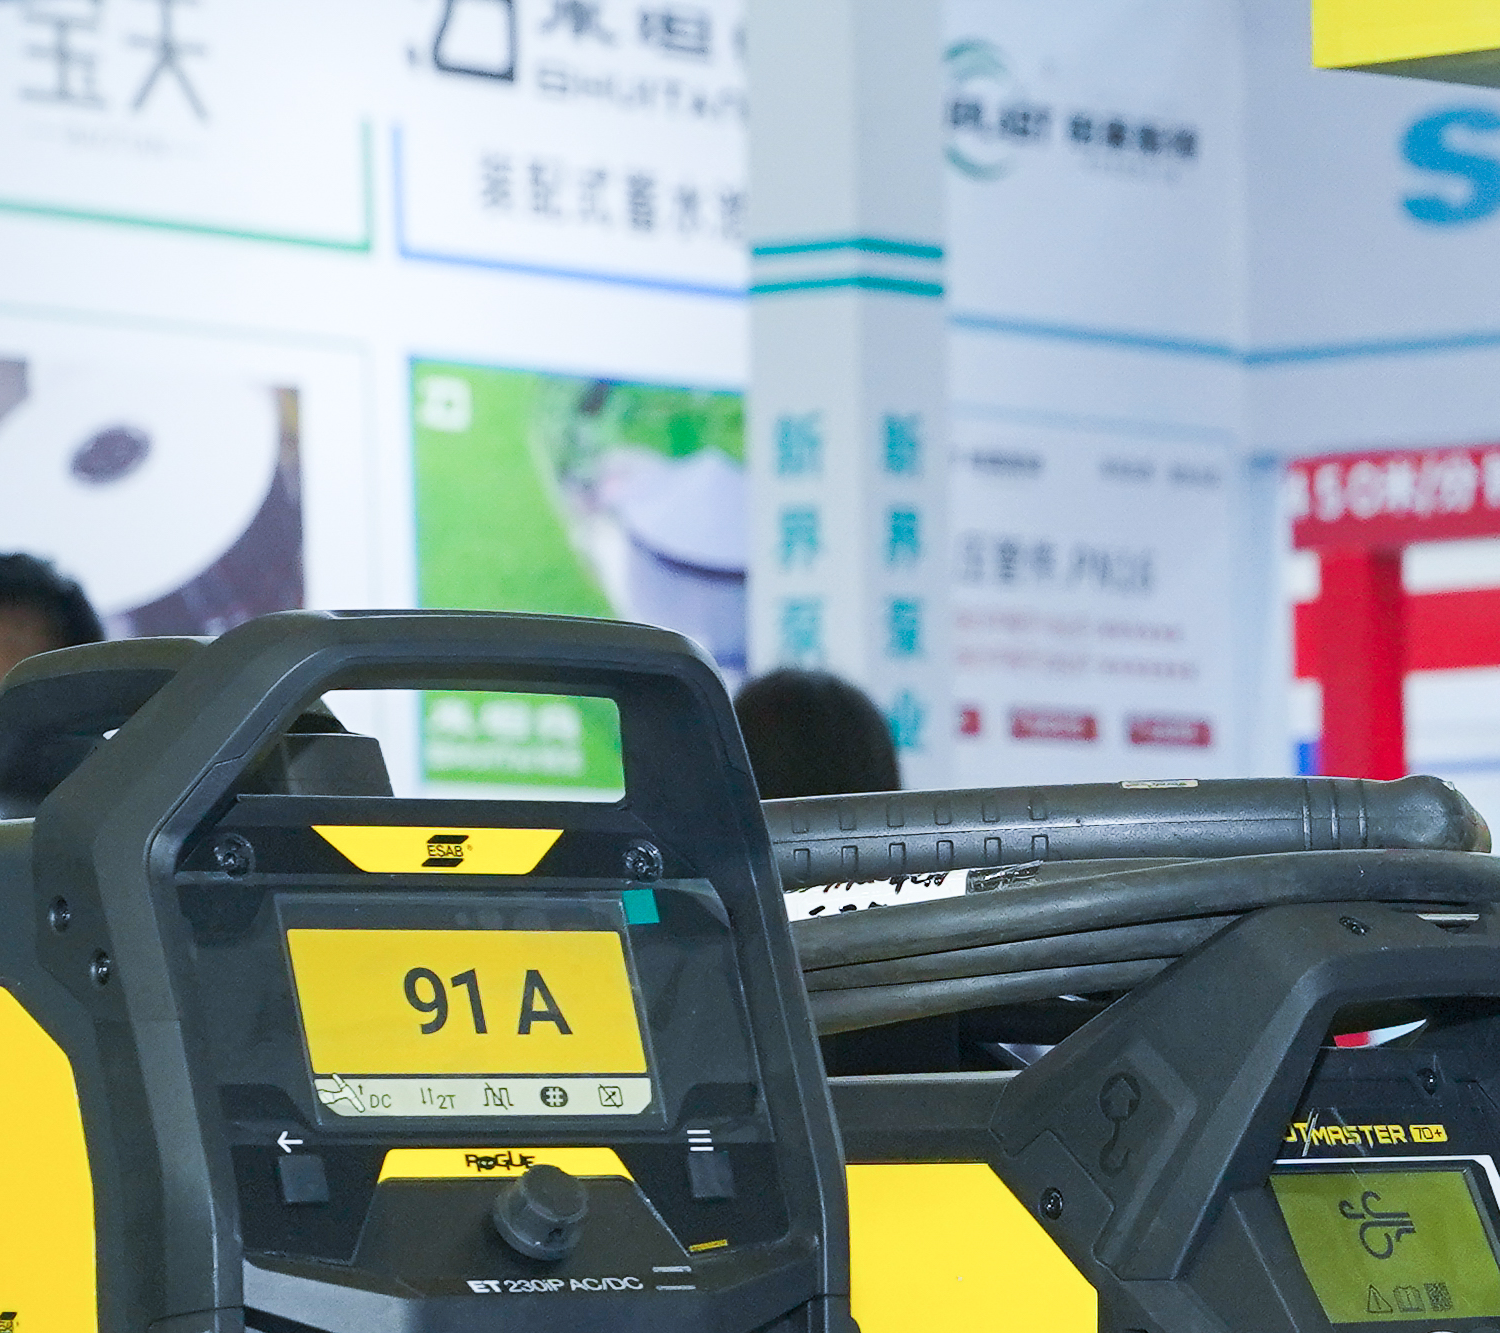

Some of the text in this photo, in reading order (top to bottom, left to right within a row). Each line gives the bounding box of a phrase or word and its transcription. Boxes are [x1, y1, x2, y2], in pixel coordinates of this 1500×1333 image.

[426, 843, 464, 858] ESAB
[403, 966, 574, 1036] 91 A
[369, 1092, 392, 1109] DC
[1414, 1126, 1444, 1142] 70+
[466, 1274, 644, 1294] ET 230iP AC/DC
